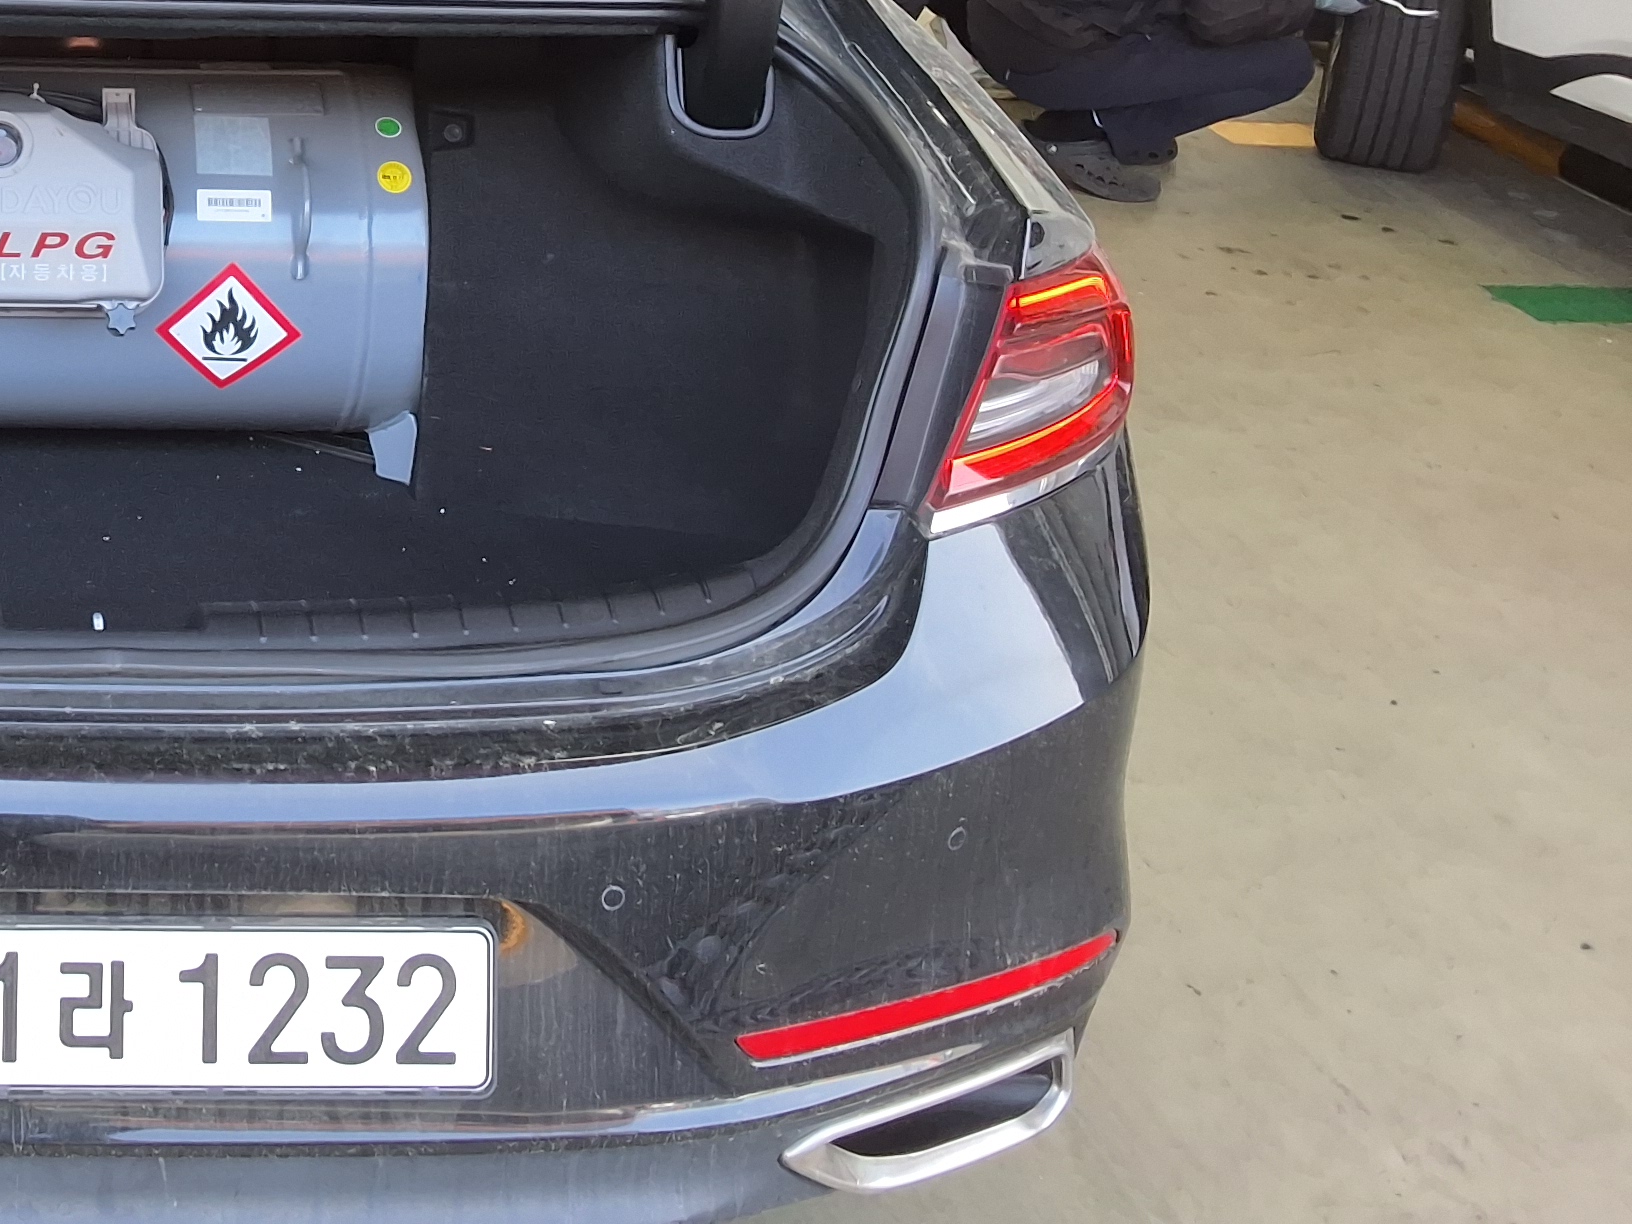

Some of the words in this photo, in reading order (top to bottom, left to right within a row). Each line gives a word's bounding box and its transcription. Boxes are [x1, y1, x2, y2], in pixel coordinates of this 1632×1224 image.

[0, 181, 123, 215] DAYOU
[0, 263, 107, 282] [자동차용]
[178, 951, 458, 1065] 1232
